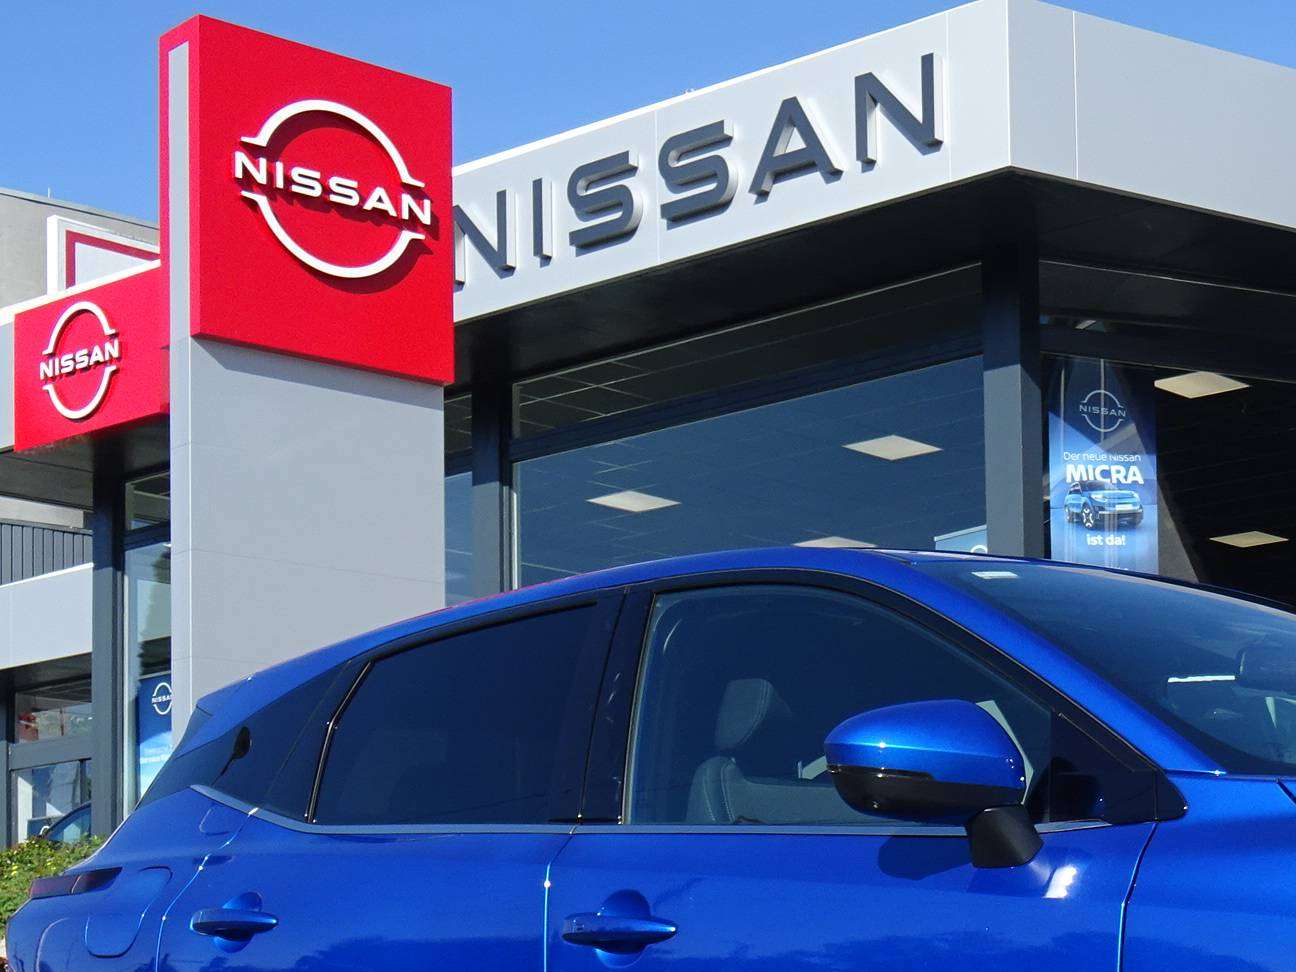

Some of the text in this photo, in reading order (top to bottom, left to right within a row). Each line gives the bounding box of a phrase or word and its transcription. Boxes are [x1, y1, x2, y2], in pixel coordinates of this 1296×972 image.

[453, 53, 943, 285] NISSAN
[232, 150, 432, 226] NISSAN
[39, 338, 120, 380] NISSAN
[1079, 404, 1126, 417] NISSAN
[1063, 451, 1080, 461] Der
[1082, 452, 1107, 462] neue
[1065, 463, 1144, 484] MICRA
[1086, 534, 1126, 546] ist da!
[151, 694, 173, 705] NISSA
